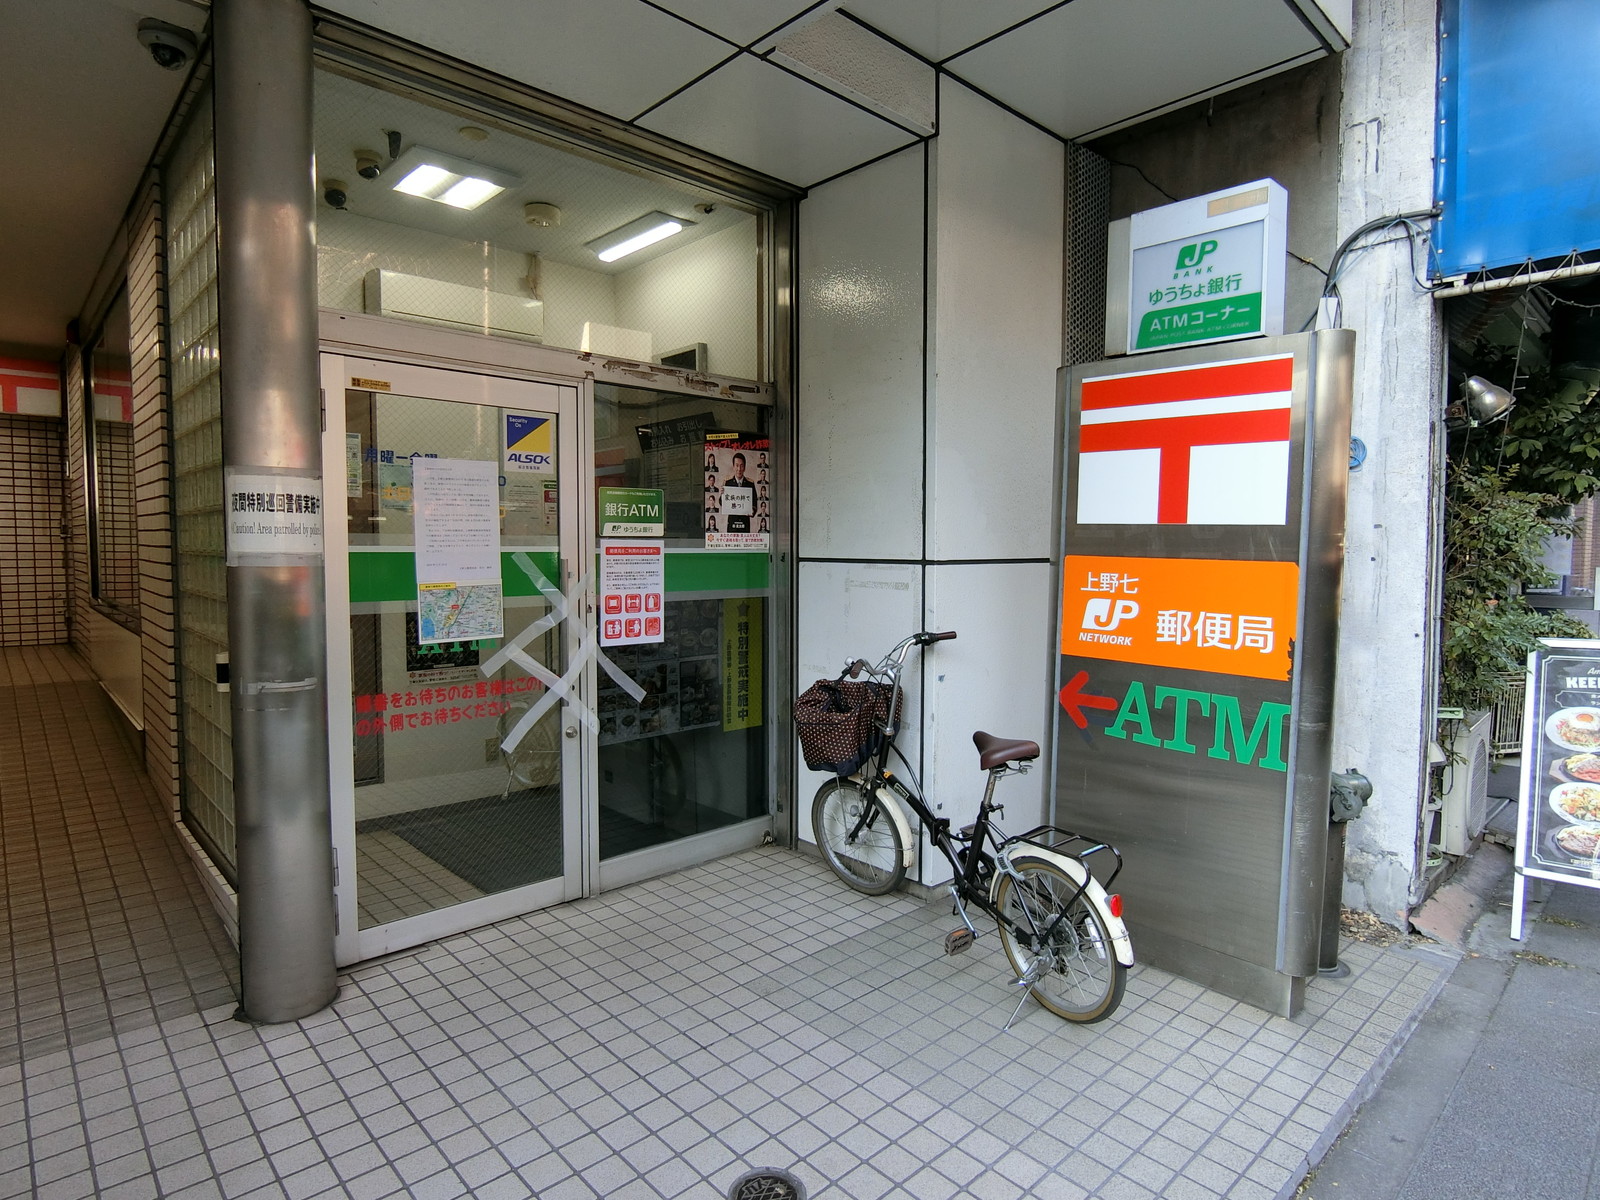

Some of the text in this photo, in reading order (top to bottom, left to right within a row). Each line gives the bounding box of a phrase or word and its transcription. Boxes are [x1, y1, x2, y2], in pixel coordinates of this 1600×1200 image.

[1173, 266, 1213, 280] BANK
[1149, 273, 1242, 306] ゆうちょ銀行
[1150, 305, 1250, 332] ATMコーナー
[508, 453, 551, 465] ALSOK
[605, 502, 659, 517] 銀行ATM
[257, 522, 273, 535] Area
[274, 522, 302, 537] patrolled
[302, 522, 309, 538] by
[1081, 572, 1140, 594] 上野七
[1078, 632, 1133, 646] NETWORK
[1156, 609, 1275, 654] 郵便局
[1566, 677, 1600, 688] KEE
[1104, 681, 1291, 772] ATM
